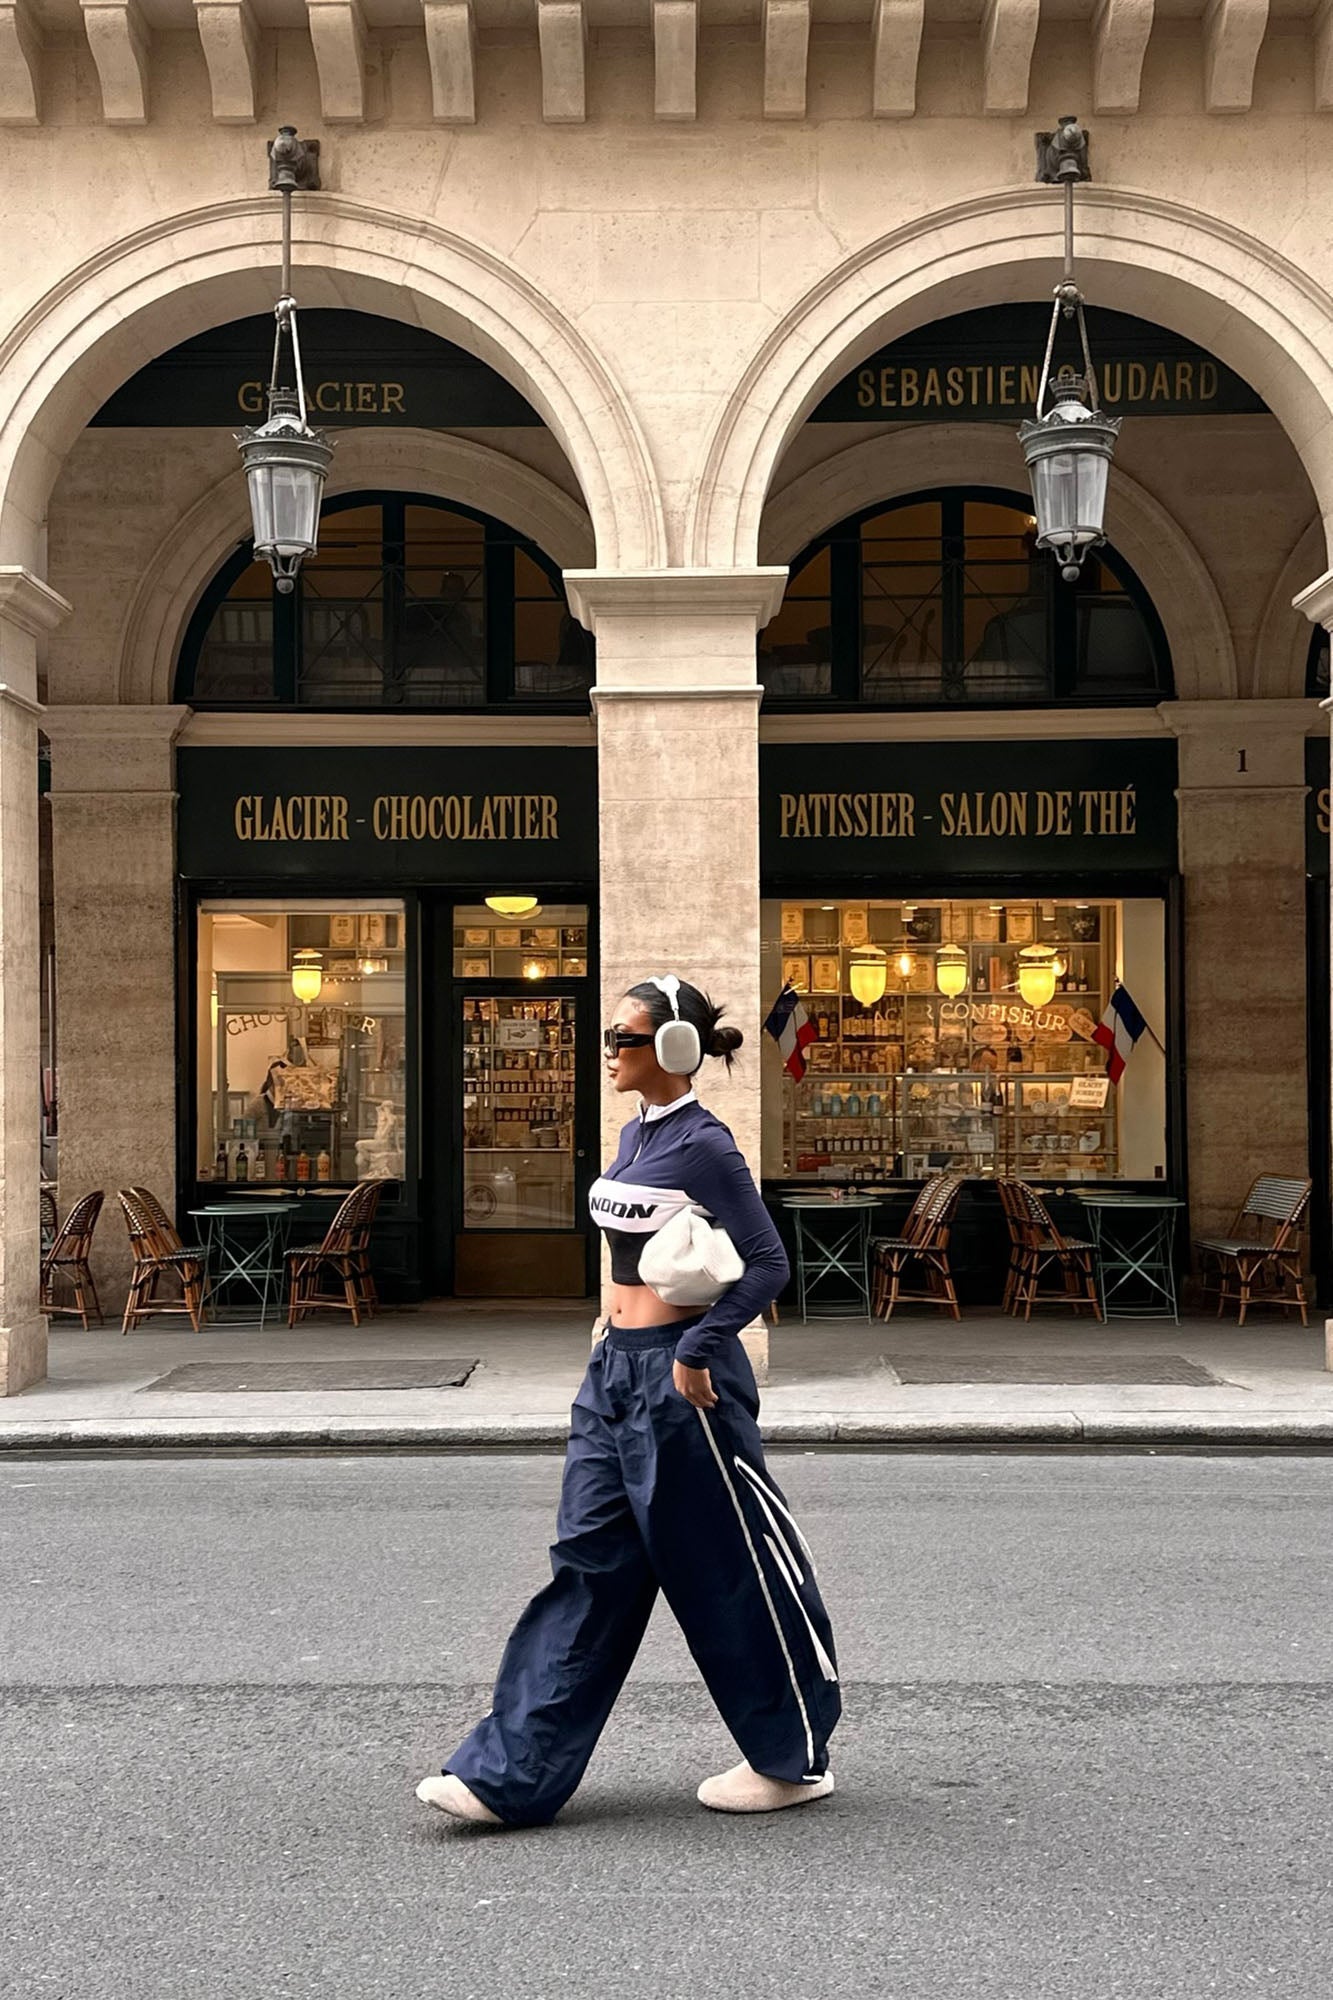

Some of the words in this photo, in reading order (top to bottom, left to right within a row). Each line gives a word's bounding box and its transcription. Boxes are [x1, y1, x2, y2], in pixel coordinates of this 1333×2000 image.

[238, 382, 406, 413] GCIER
[857, 365, 1038, 407] SEBASTIEN
[1237, 749, 1248, 772] 1
[234, 795, 349, 840] GLACIER
[373, 795, 559, 840] CHOCOLATIER
[779, 793, 916, 838] PATISSIER
[940, 792, 1028, 836] SALON
[1035, 791, 1073, 836] DE
[1078, 783, 1137, 835] THÉ
[939, 1002, 1066, 1031] CONFISEUR
